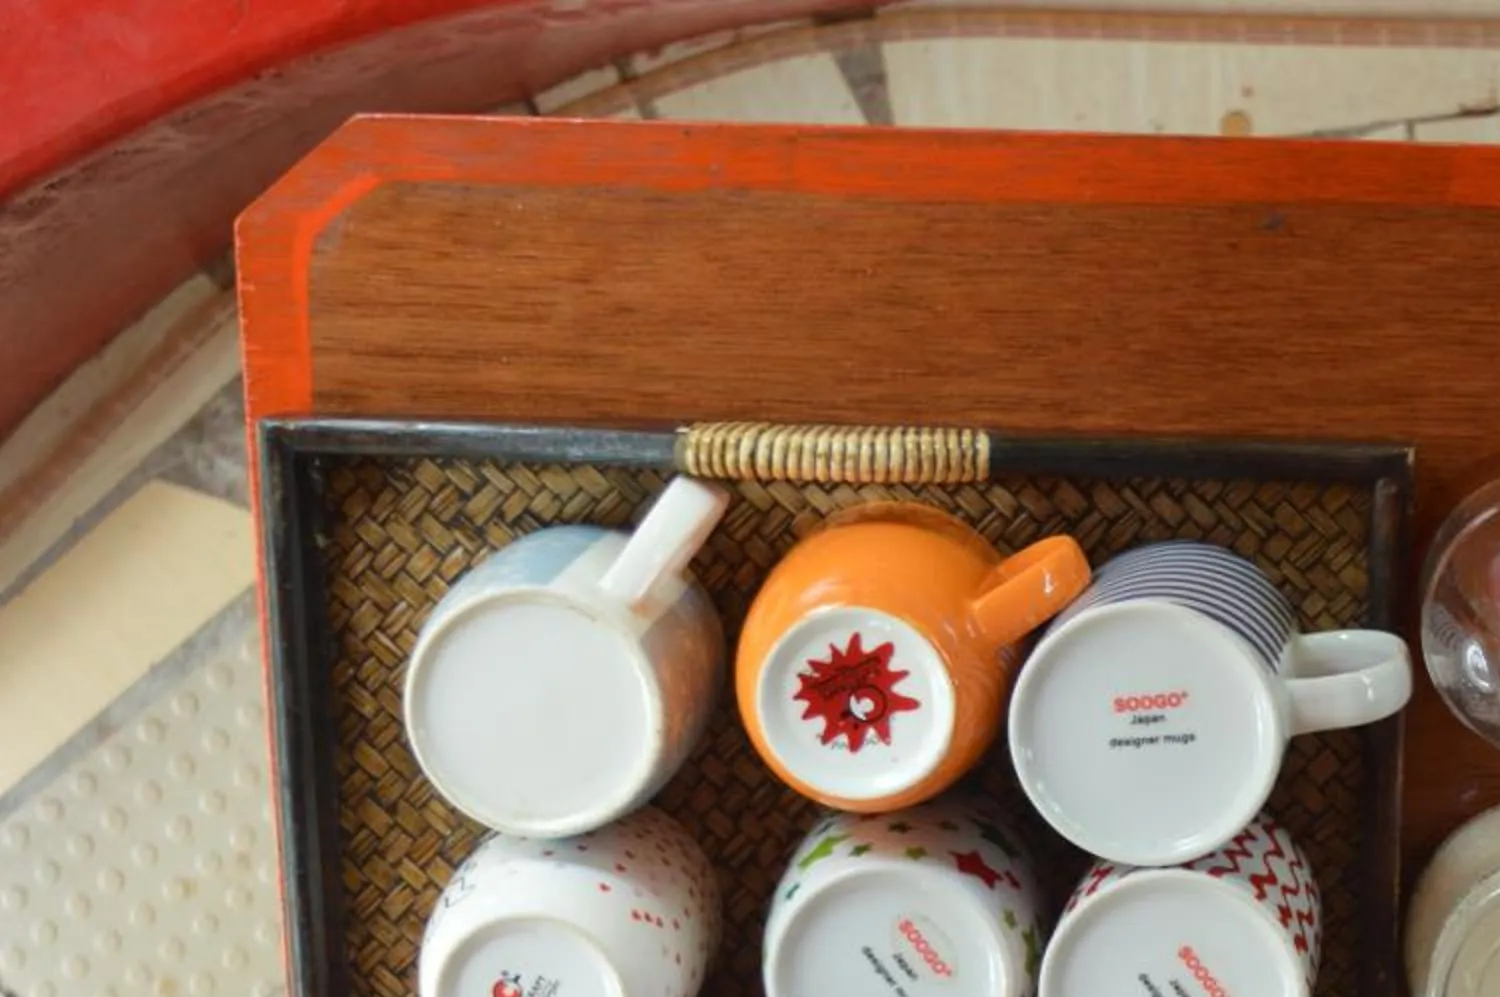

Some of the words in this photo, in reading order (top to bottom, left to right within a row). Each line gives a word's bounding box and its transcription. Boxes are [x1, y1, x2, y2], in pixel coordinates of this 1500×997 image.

[1113, 691, 1186, 713] SOOGO
[1130, 714, 1167, 727] Japan
[1108, 736, 1160, 749] designer
[1162, 732, 1196, 746] mugs
